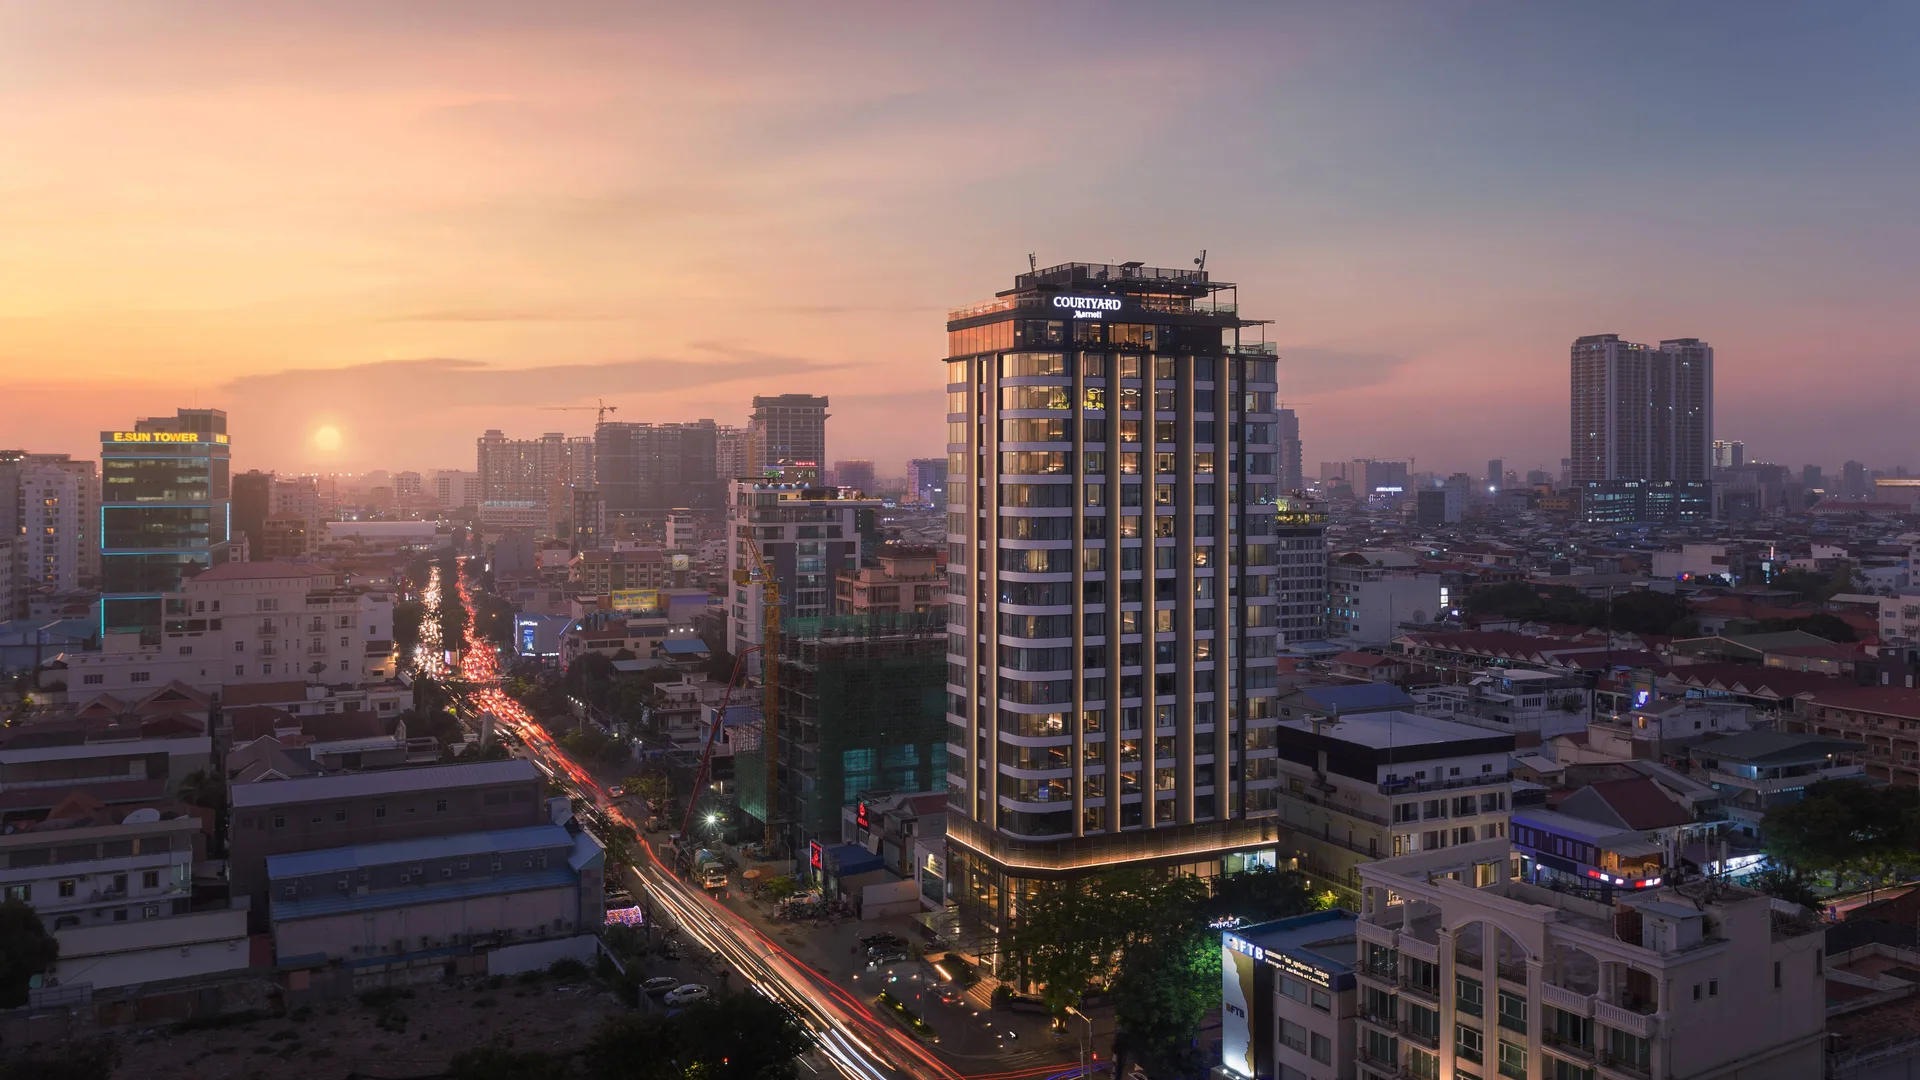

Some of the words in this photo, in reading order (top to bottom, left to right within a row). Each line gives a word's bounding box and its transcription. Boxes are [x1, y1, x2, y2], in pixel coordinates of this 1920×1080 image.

[1053, 296, 1122, 310] COURTYARD
[1073, 310, 1102, 319] Marriott
[113, 432, 151, 442] E.SUN
[153, 432, 198, 442] TOWER
[1239, 940, 1264, 960] FTB
[1230, 1007, 1245, 1019] FTB
